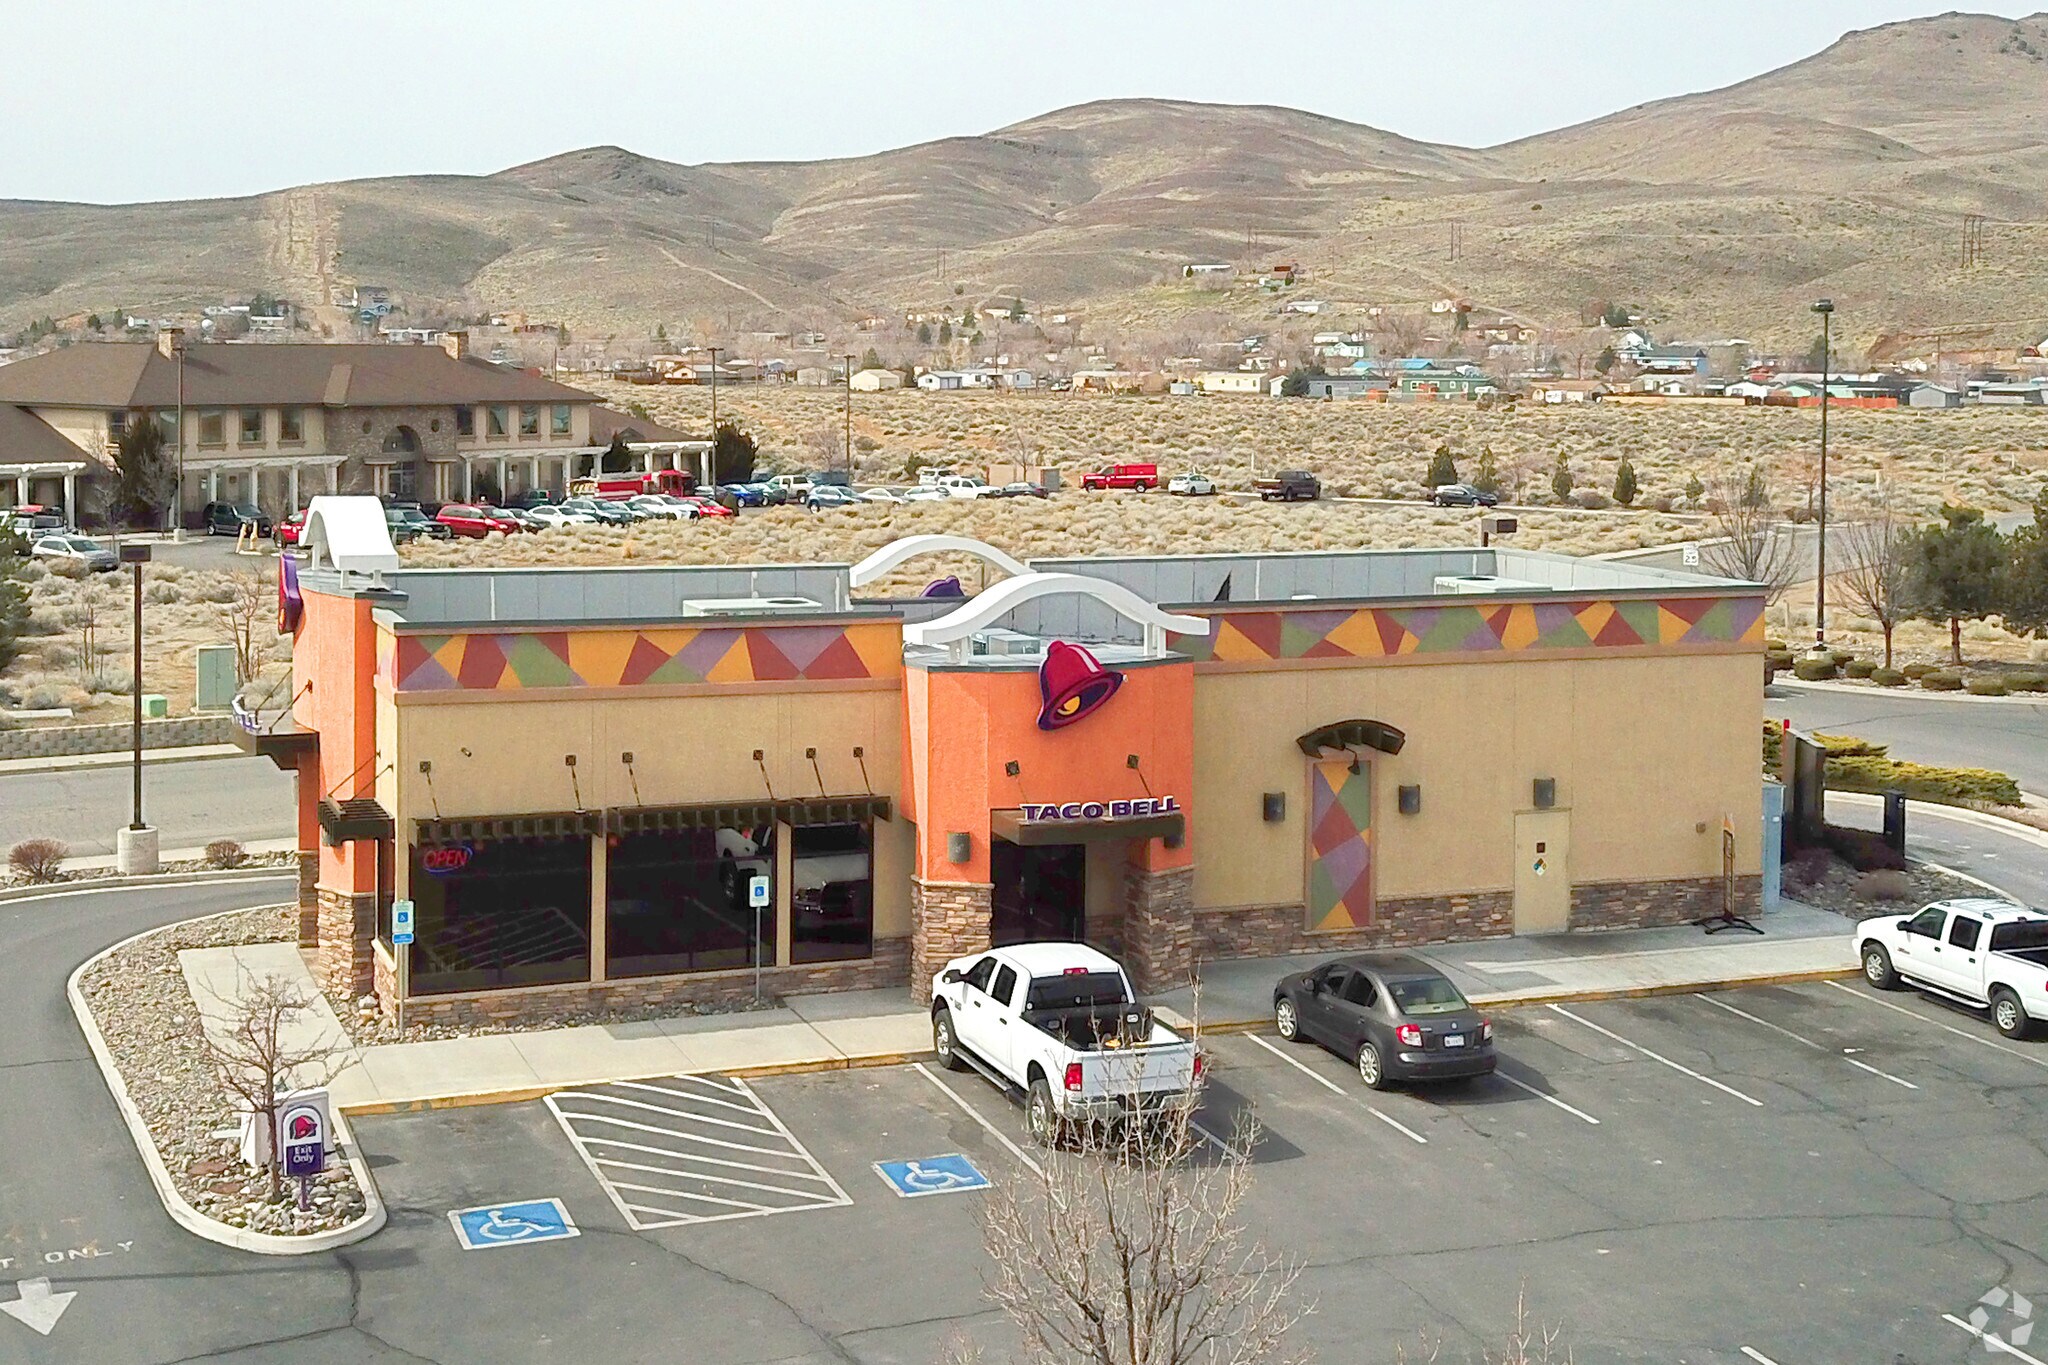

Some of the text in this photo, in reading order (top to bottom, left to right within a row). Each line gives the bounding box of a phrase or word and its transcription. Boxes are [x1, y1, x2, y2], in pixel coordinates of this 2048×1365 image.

[1020, 796, 1180, 820] TACO BELL
[424, 849, 468, 867] OPEN
[293, 1153, 314, 1163] Only
[294, 1145, 312, 1154] Exit
[45, 1241, 133, 1263] ONLY
